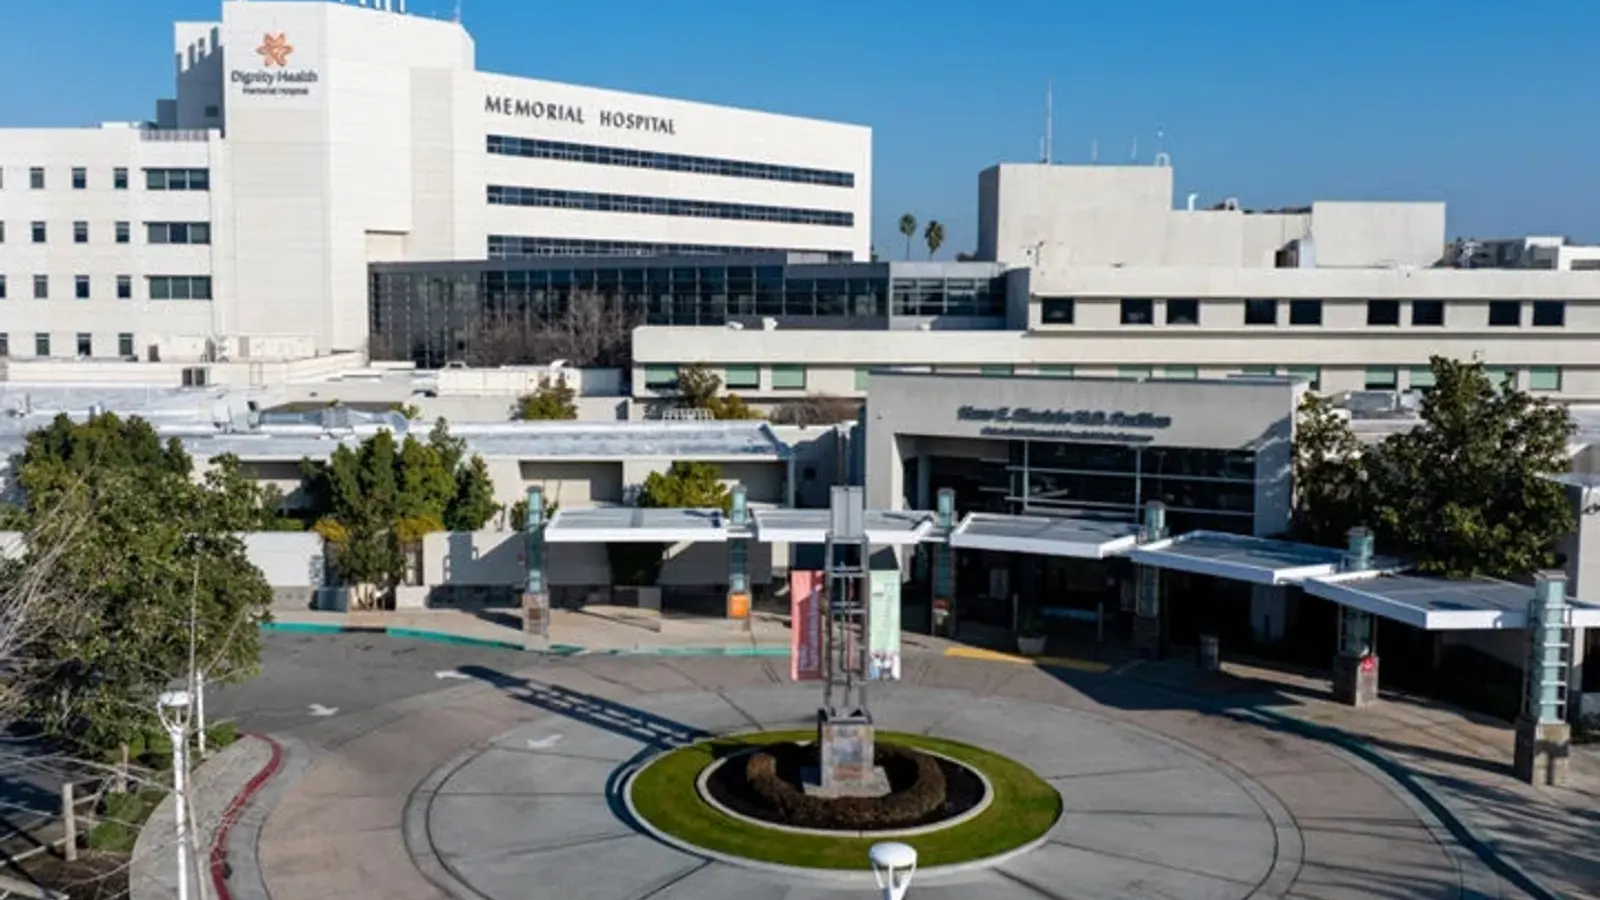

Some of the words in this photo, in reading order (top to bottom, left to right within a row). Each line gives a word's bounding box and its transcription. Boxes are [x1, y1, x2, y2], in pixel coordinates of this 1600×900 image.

[231, 70, 274, 87] Dignity
[277, 70, 318, 82] Health
[484, 94, 584, 124] MEMORIAL
[600, 110, 676, 135] HOSPITAL
